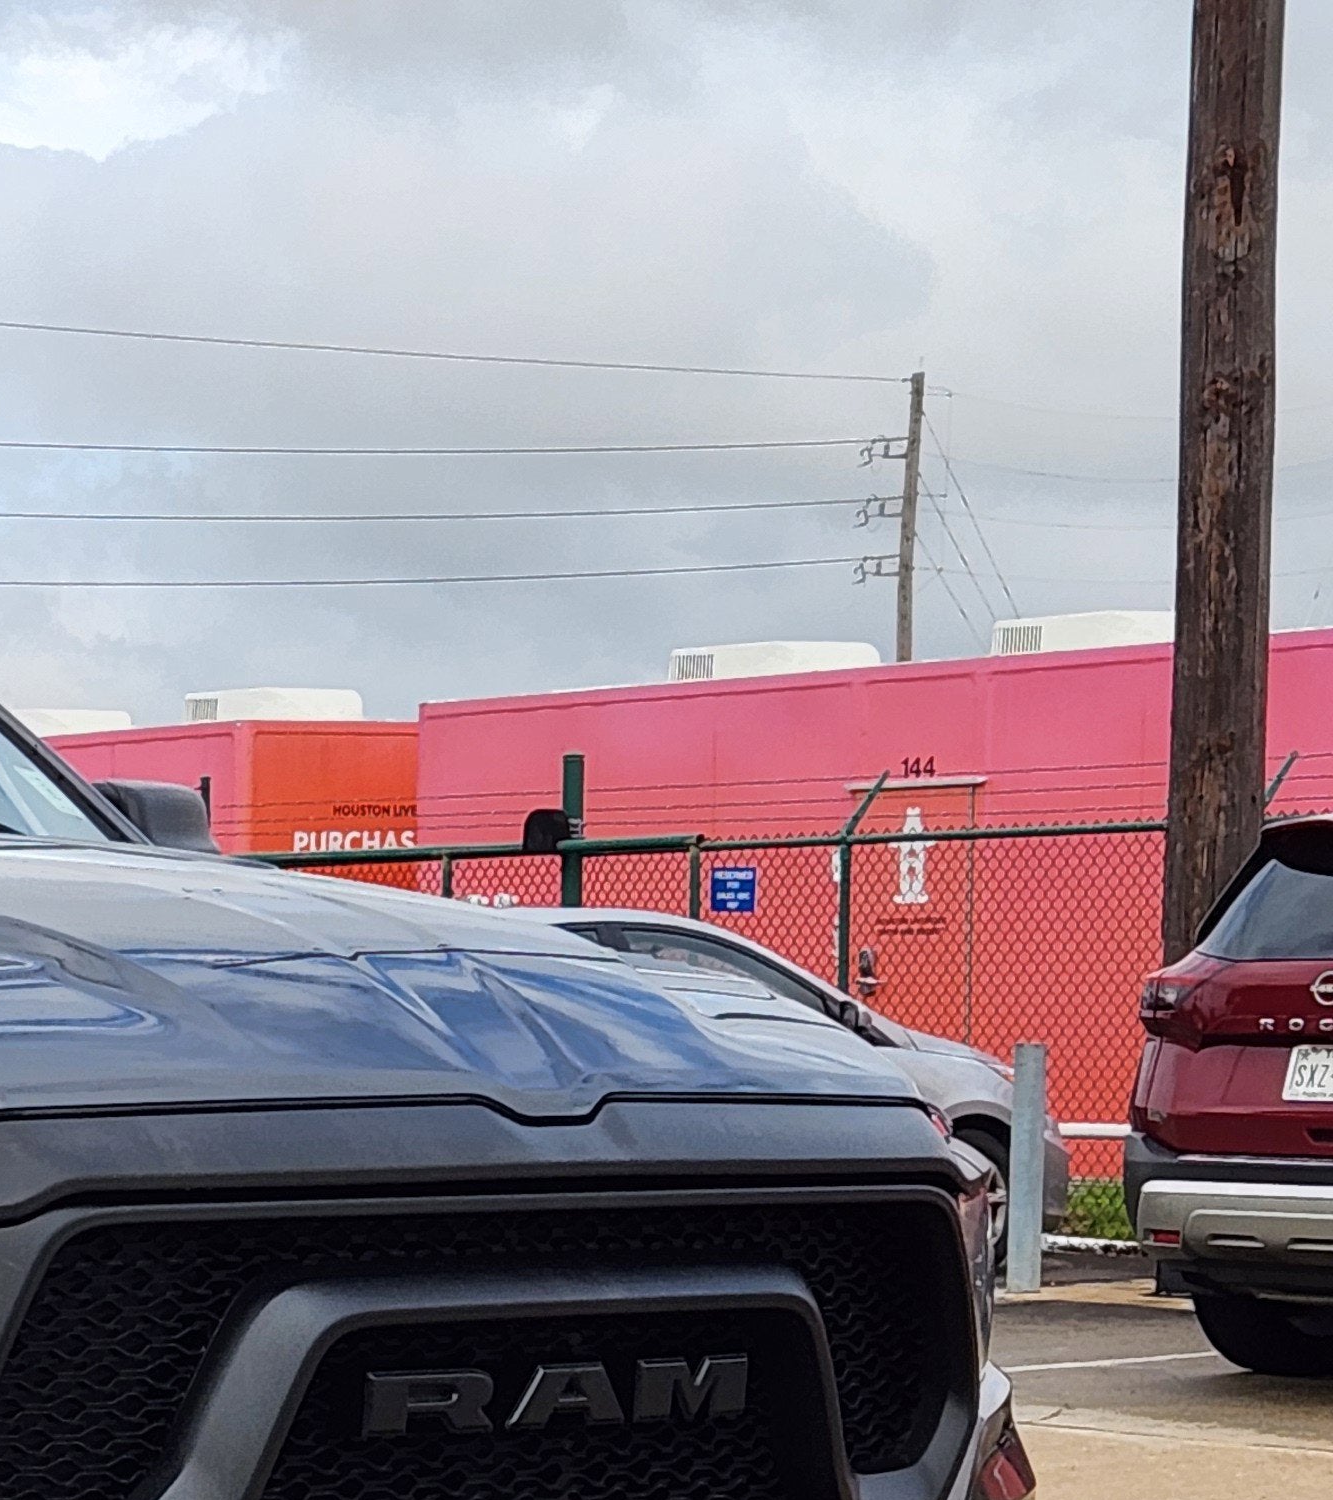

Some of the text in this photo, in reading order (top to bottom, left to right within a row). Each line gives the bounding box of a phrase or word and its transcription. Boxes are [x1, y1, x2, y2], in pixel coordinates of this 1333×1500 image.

[900, 756, 936, 778] 144
[333, 804, 391, 817] HOUSTON
[362, 1353, 748, 1438] RAM
